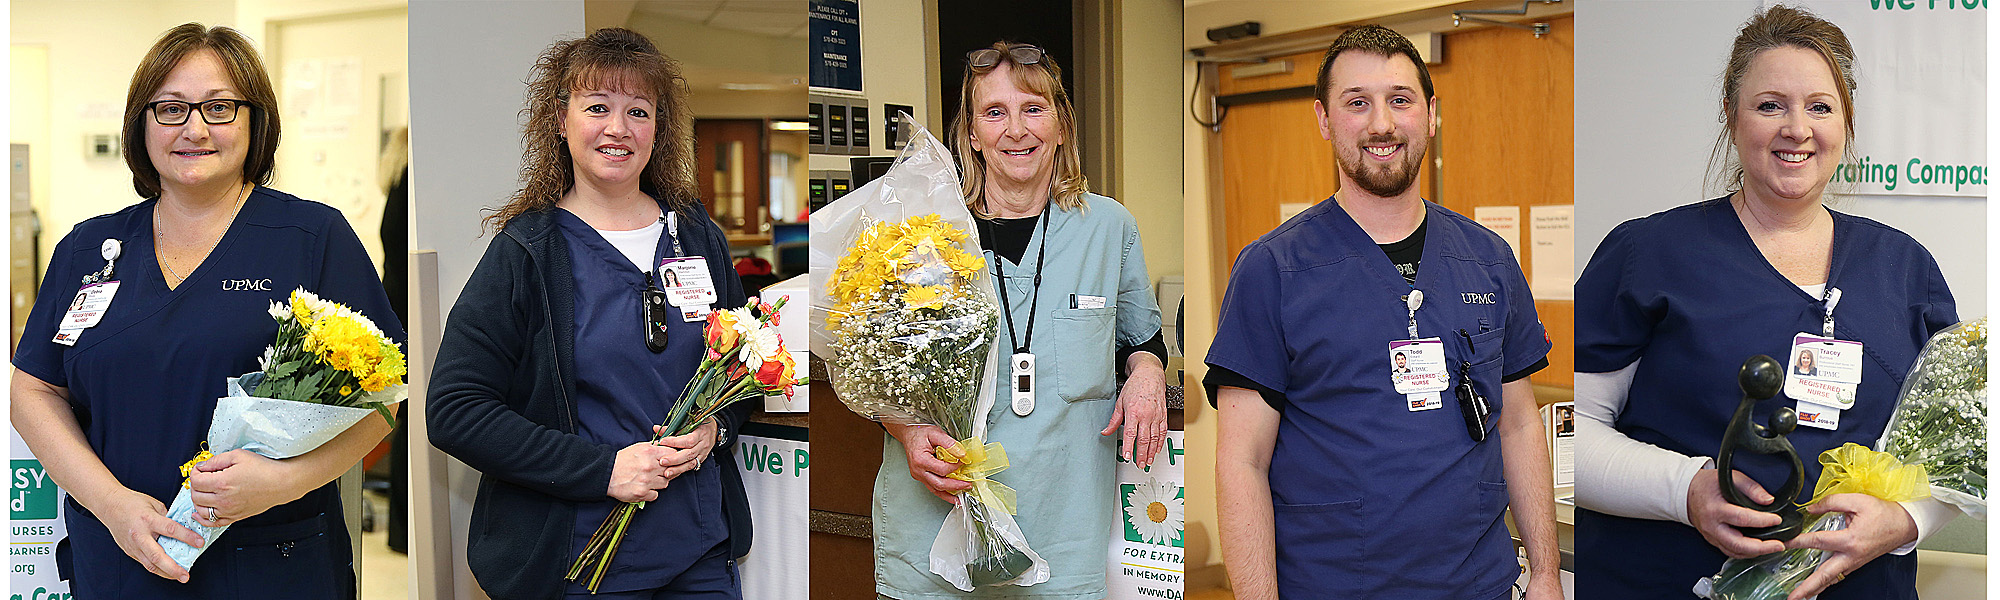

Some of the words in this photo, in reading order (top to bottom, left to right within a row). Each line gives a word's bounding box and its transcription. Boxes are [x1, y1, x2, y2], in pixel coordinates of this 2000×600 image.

[1829, 156, 1898, 191] rating
[221, 278, 272, 291] UPMC
[1460, 292, 1496, 305] UPMC
[1820, 348, 1841, 357] Tracey
[1818, 370, 1840, 379] UPMC
[1798, 378, 1841, 393] REGISTERED
[1806, 388, 1831, 399] NURSE
[742, 442, 783, 474] We
[795, 449, 809, 477] P
[12, 526, 54, 536] URSES
[1124, 547, 1147, 559] FOR
[11, 564, 35, 576] .org
[1123, 567, 1133, 576] IN
[1136, 570, 1180, 583] MEMORY
